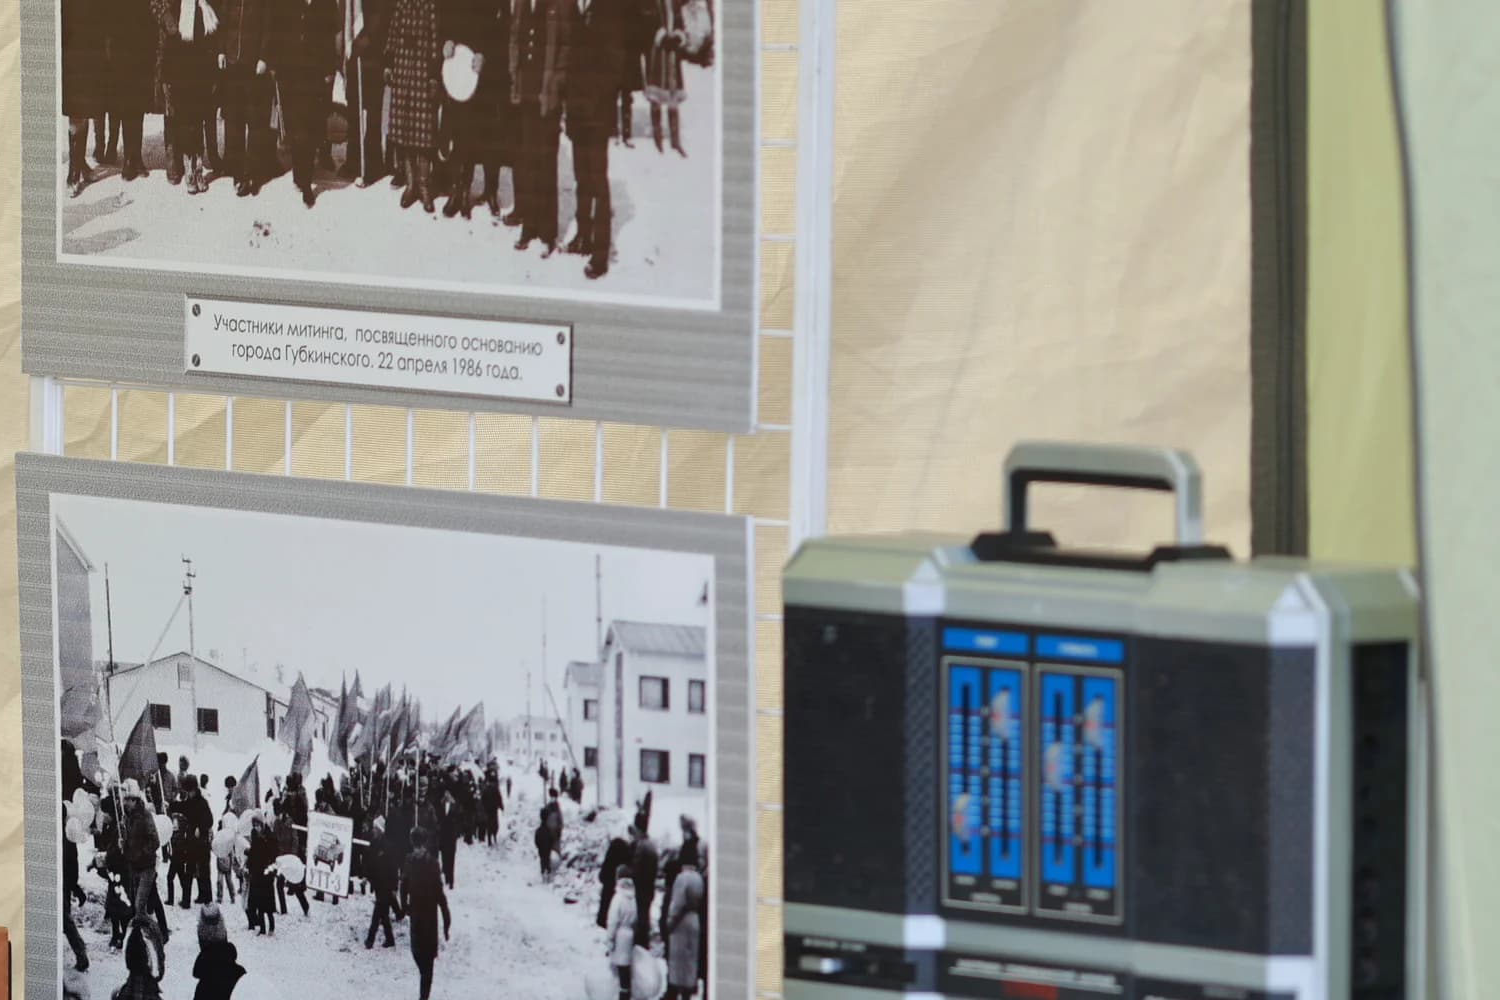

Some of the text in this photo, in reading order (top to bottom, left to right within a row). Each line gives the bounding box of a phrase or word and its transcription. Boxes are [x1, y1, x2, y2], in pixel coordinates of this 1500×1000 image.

[213, 314, 543, 357] Участники митинга, посвященного основанию
[232, 343, 523, 381] города Губкинского. 22 апреля 1986 года.
